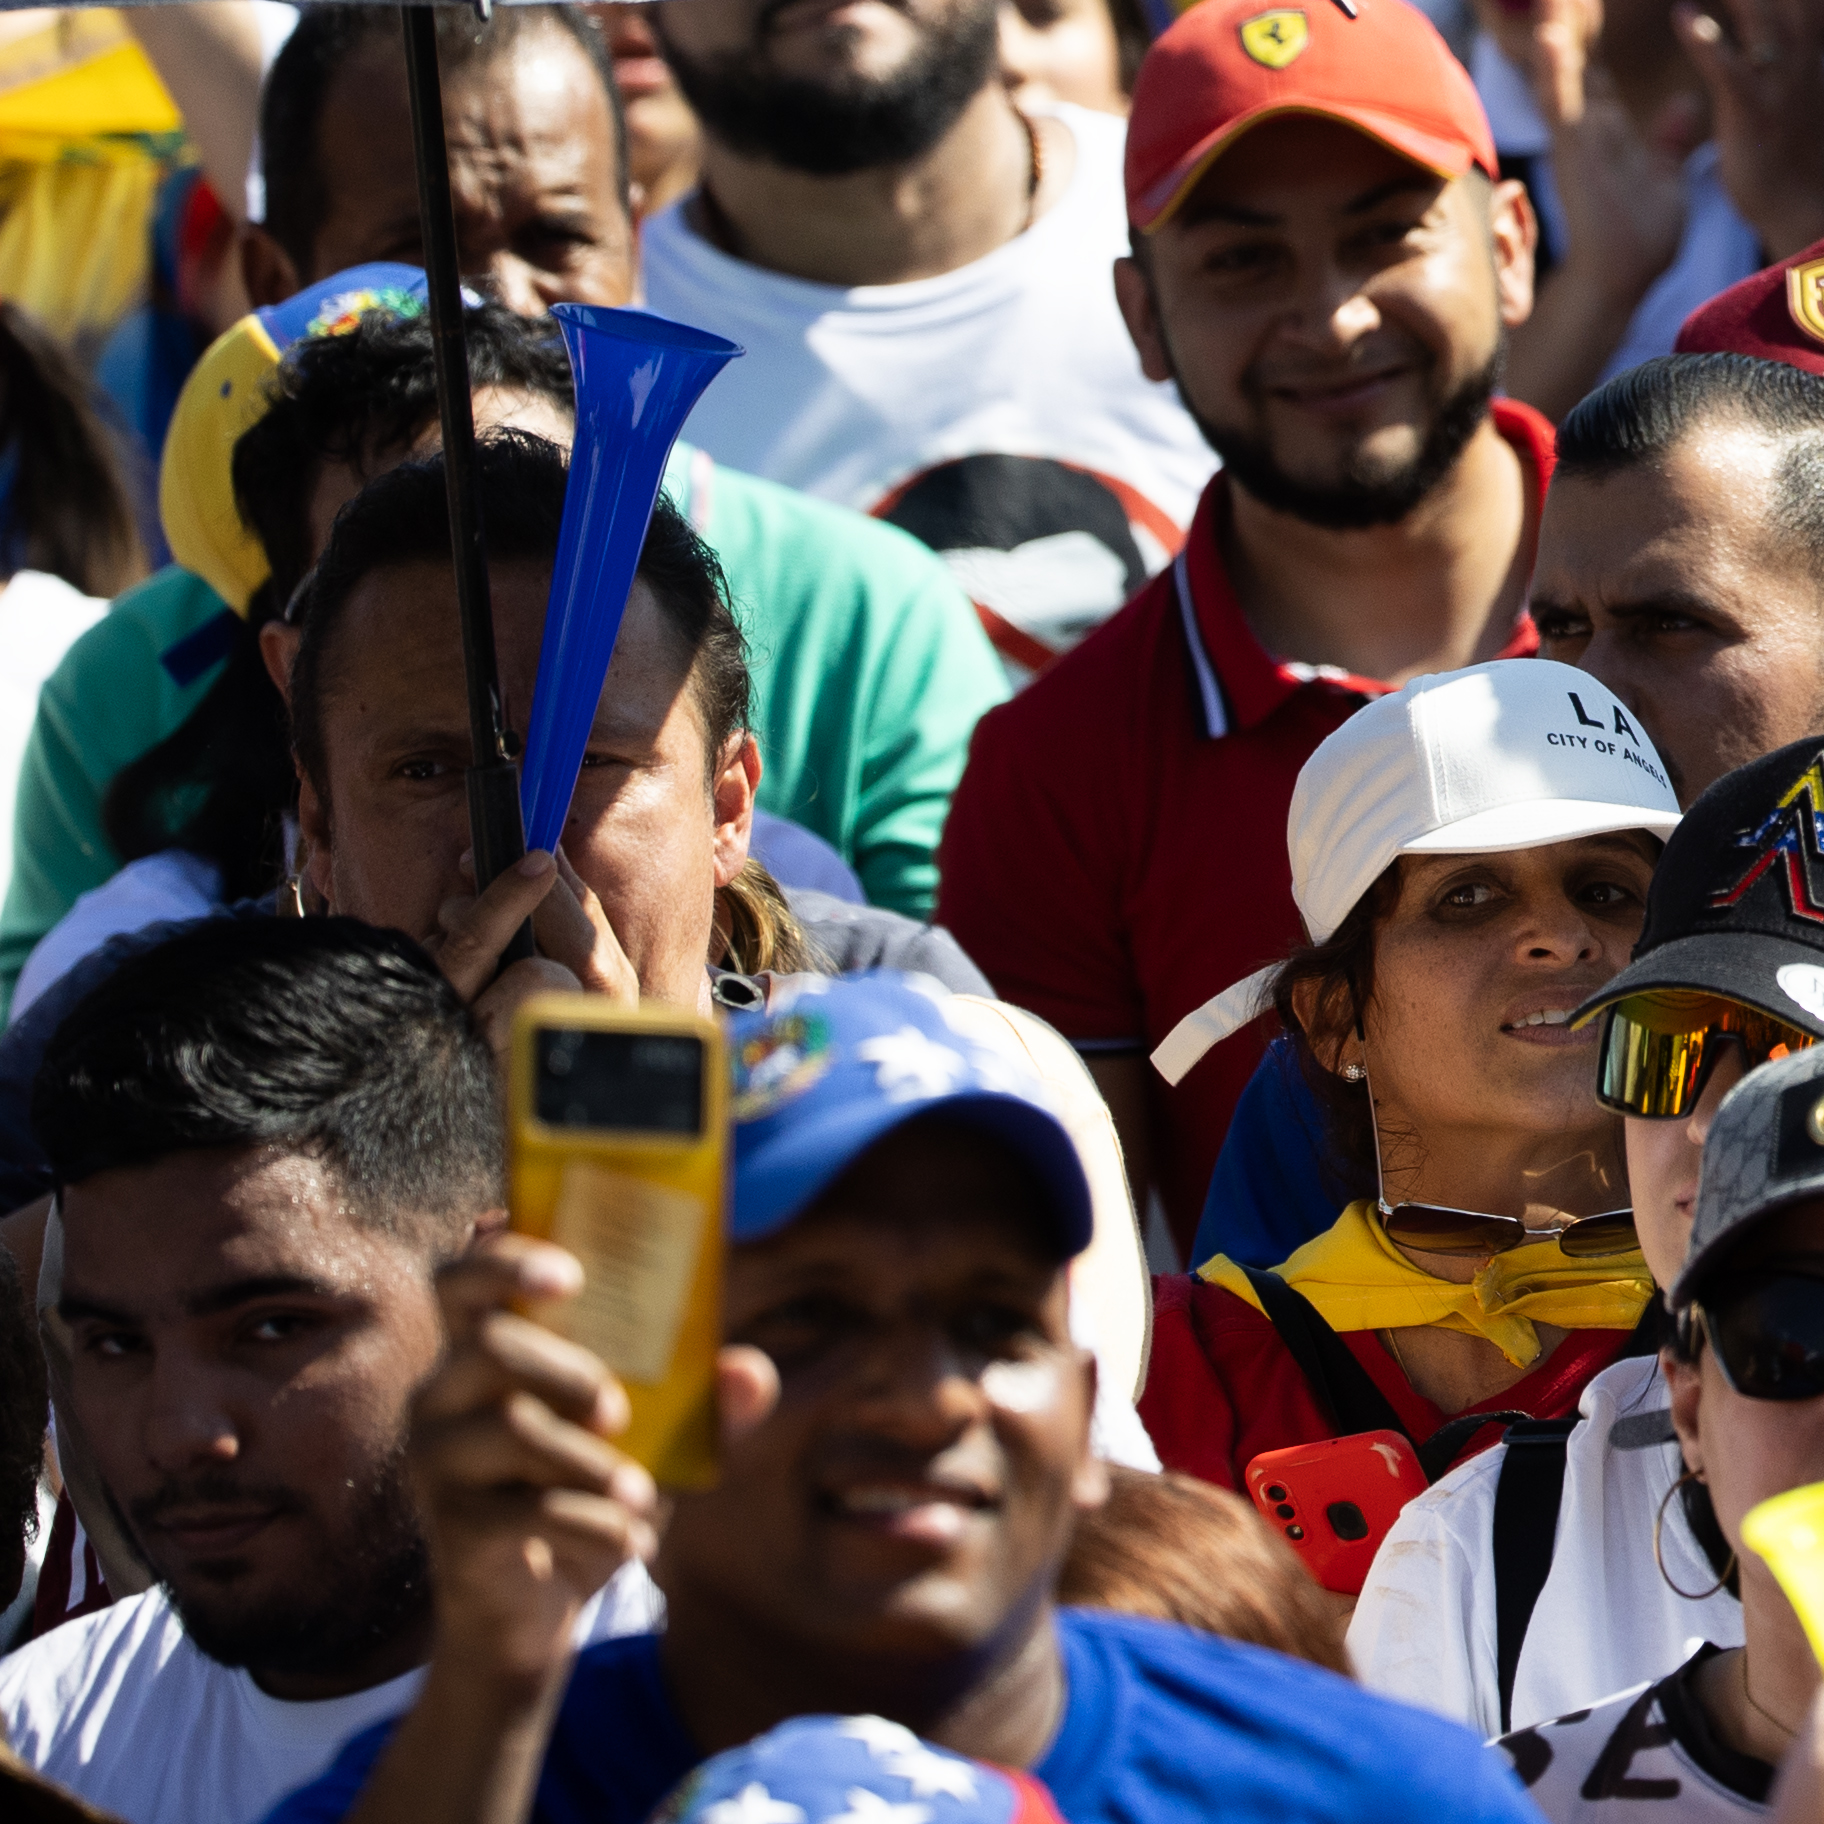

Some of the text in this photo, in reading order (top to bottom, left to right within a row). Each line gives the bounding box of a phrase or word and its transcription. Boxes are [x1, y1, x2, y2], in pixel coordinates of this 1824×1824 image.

[1567, 691, 1641, 748] LA
[1547, 732, 1587, 749] CITY
[1594, 739, 1616, 755] OF
